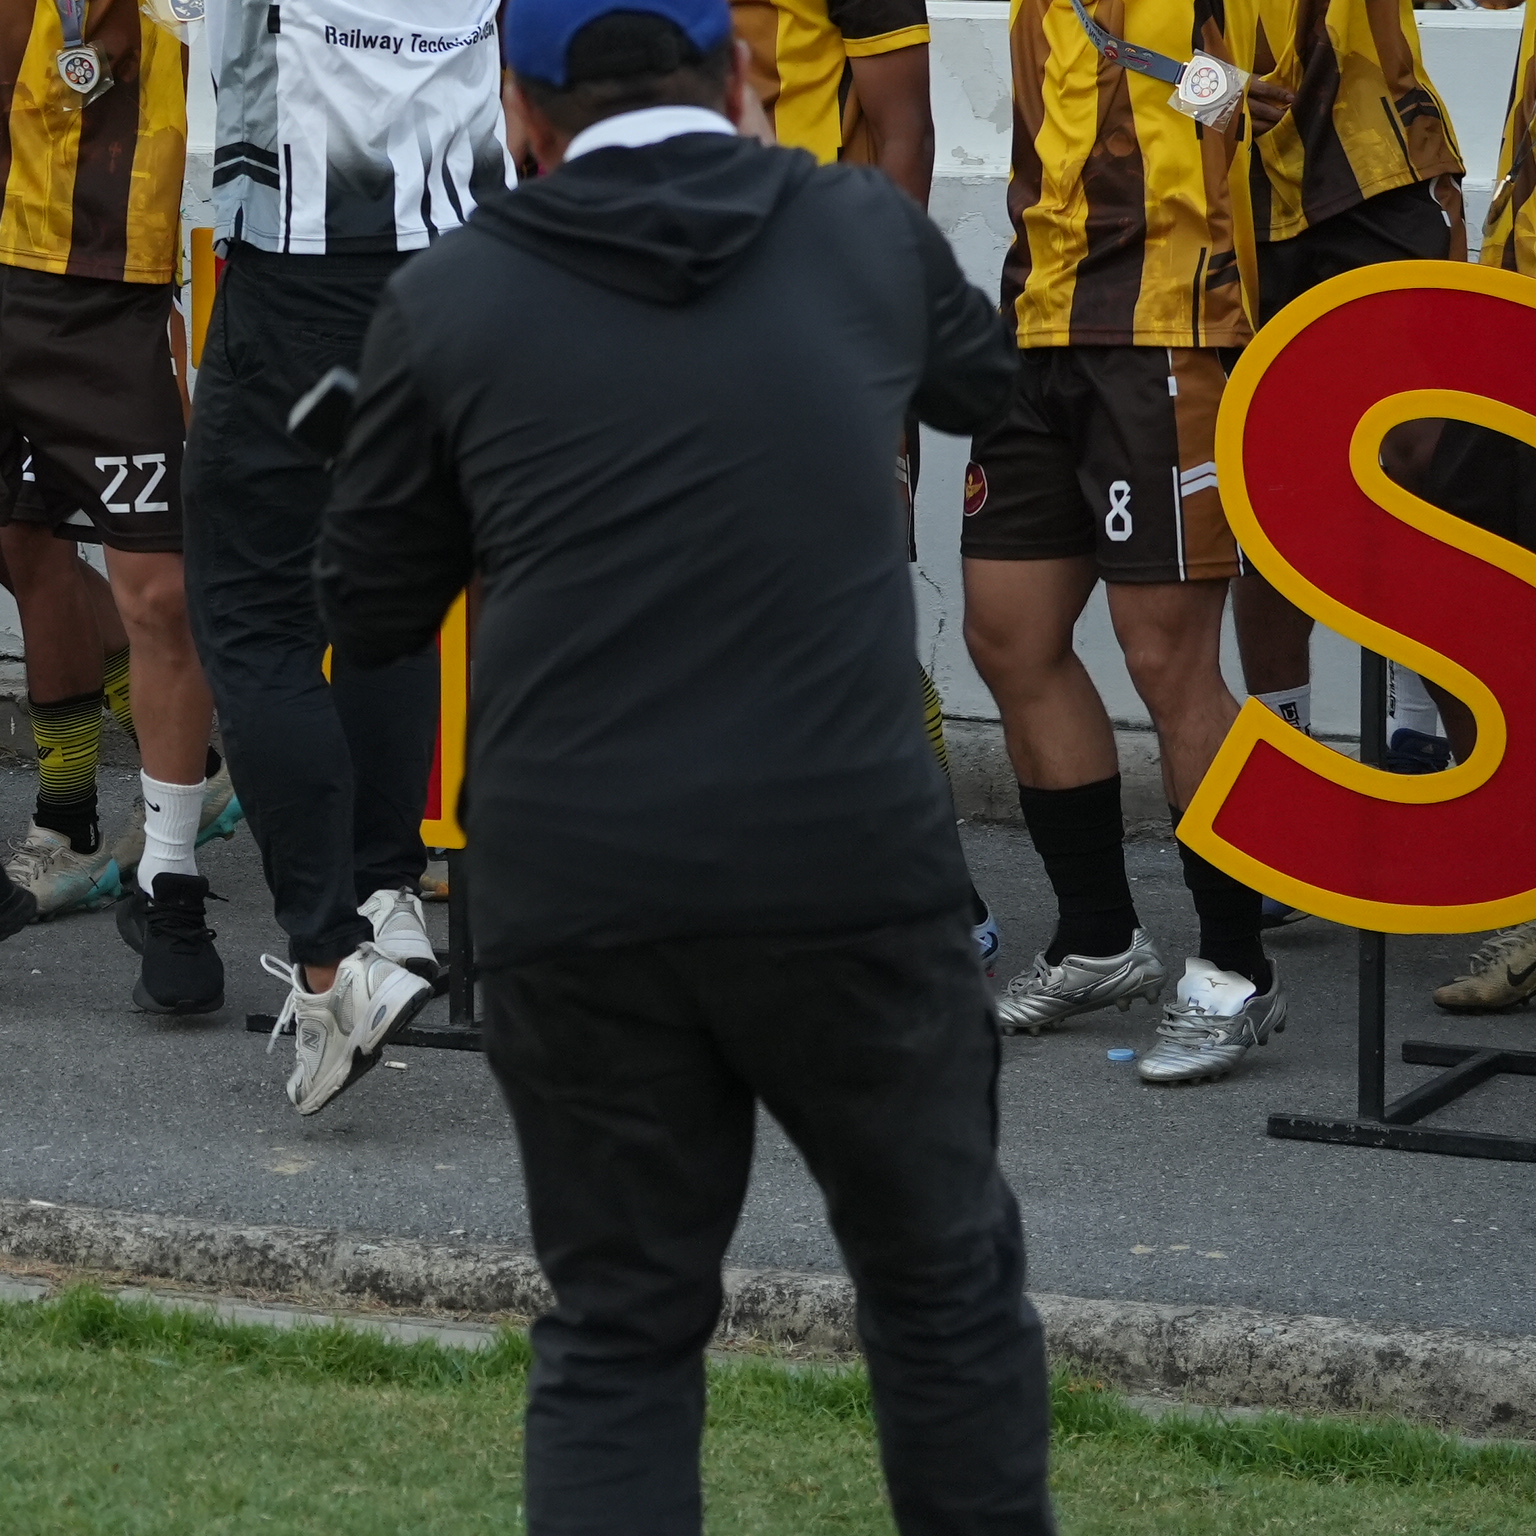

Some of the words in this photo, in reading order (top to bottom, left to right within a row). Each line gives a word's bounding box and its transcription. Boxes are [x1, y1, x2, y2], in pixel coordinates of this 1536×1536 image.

[324, 25, 403, 55] Railway
[94, 452, 169, 514] 22
[1104, 479, 1133, 542] 8
[1176, 260, 1536, 935] S
